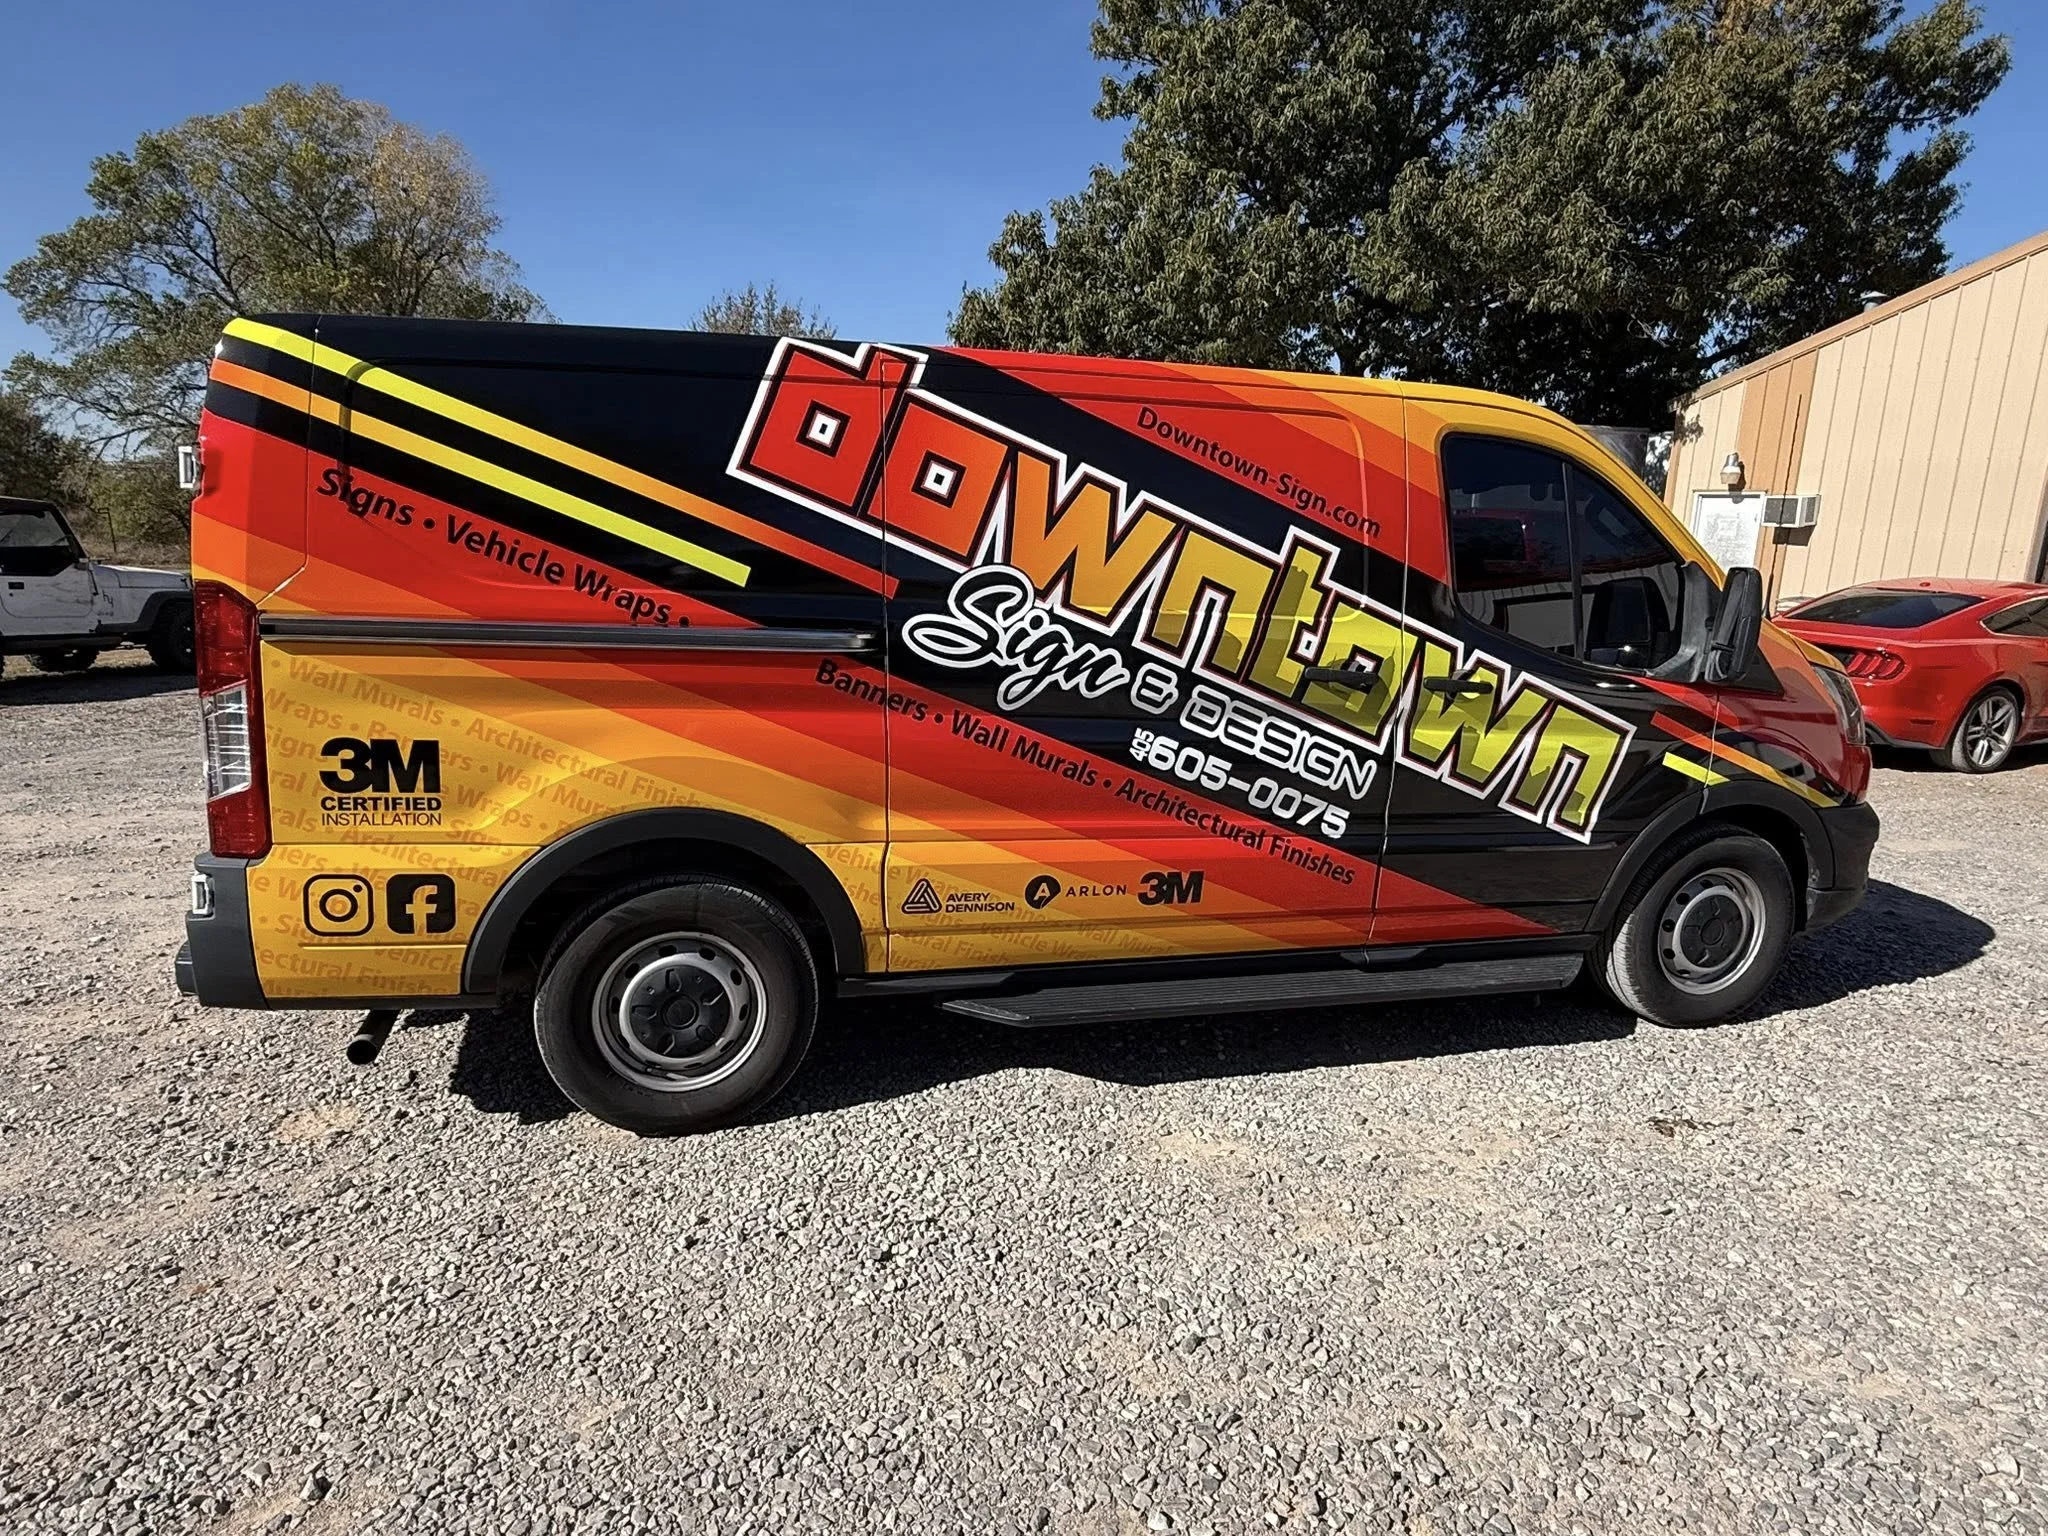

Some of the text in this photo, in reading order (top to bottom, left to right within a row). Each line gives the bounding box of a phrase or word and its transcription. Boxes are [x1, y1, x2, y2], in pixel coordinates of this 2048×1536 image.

[1137, 406, 1381, 539] Downtown-Sign.com
[316, 467, 673, 626] Signs Vehicle Wraps
[726, 336, 1636, 845] downtown
[902, 562, 1131, 711] Sign
[1180, 684, 1378, 800] DESIGN
[289, 657, 349, 694] Wall
[353, 678, 446, 726] Murals
[466, 717, 628, 793] Architectural
[318, 737, 441, 794] 3M
[815, 658, 1356, 885] Banners Wall Murals Architectural Finishes
[1129, 727, 1350, 839] 405 605-0075
[320, 796, 442, 812] CERTIFIED
[321, 812, 442, 827] INSTALLATION
[457, 784, 533, 829] Wraps
[945, 892, 990, 902] AVERY
[945, 901, 1015, 913] DENNISON
[1065, 884, 1128, 897] ARLON
[1137, 871, 1205, 906] 3M
